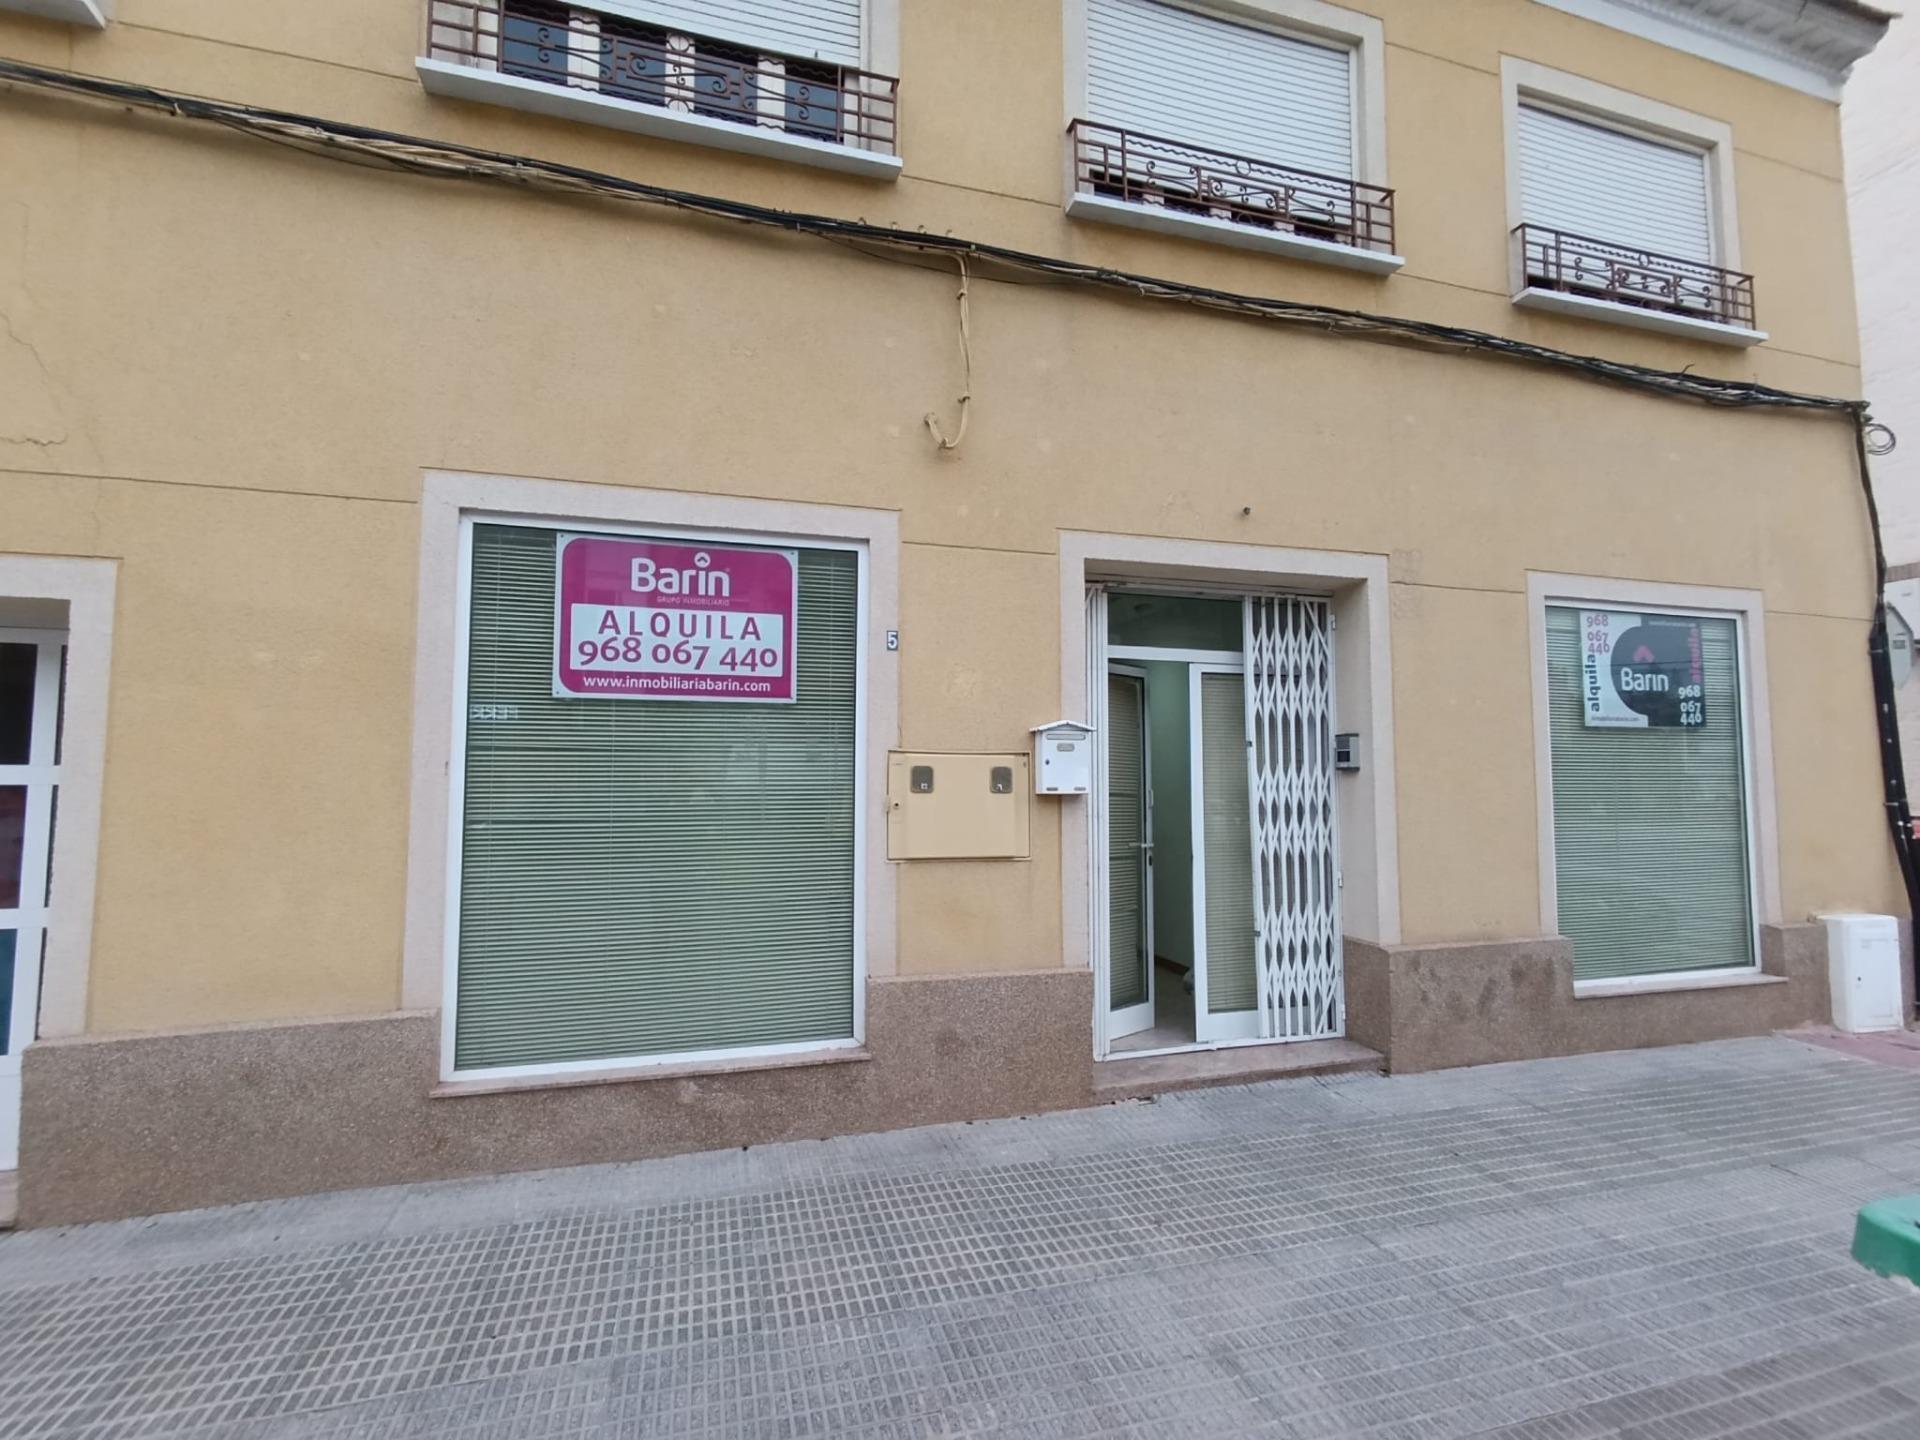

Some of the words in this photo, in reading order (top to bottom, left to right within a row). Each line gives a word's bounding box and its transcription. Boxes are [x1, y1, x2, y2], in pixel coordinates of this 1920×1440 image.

[630, 553, 731, 597] Barin
[656, 596, 681, 604] GRUPO
[683, 597, 730, 607] INMOBILIARIO
[598, 609, 761, 641] ALQUILA
[1586, 614, 1609, 628] 968
[887, 631, 898, 649] 5
[1587, 630, 1609, 644] 067
[578, 636, 642, 667] 968
[651, 640, 710, 671] 067
[719, 647, 778, 672] 440
[1588, 642, 1610, 655] 440
[583, 675, 771, 692] www.inmobiliariabarin.com
[1585, 654, 1601, 712] alquila
[1620, 667, 1669, 692] Barin
[1678, 685, 1701, 699] 968
[1680, 700, 1701, 714] 067
[1680, 712, 1703, 726] 440
